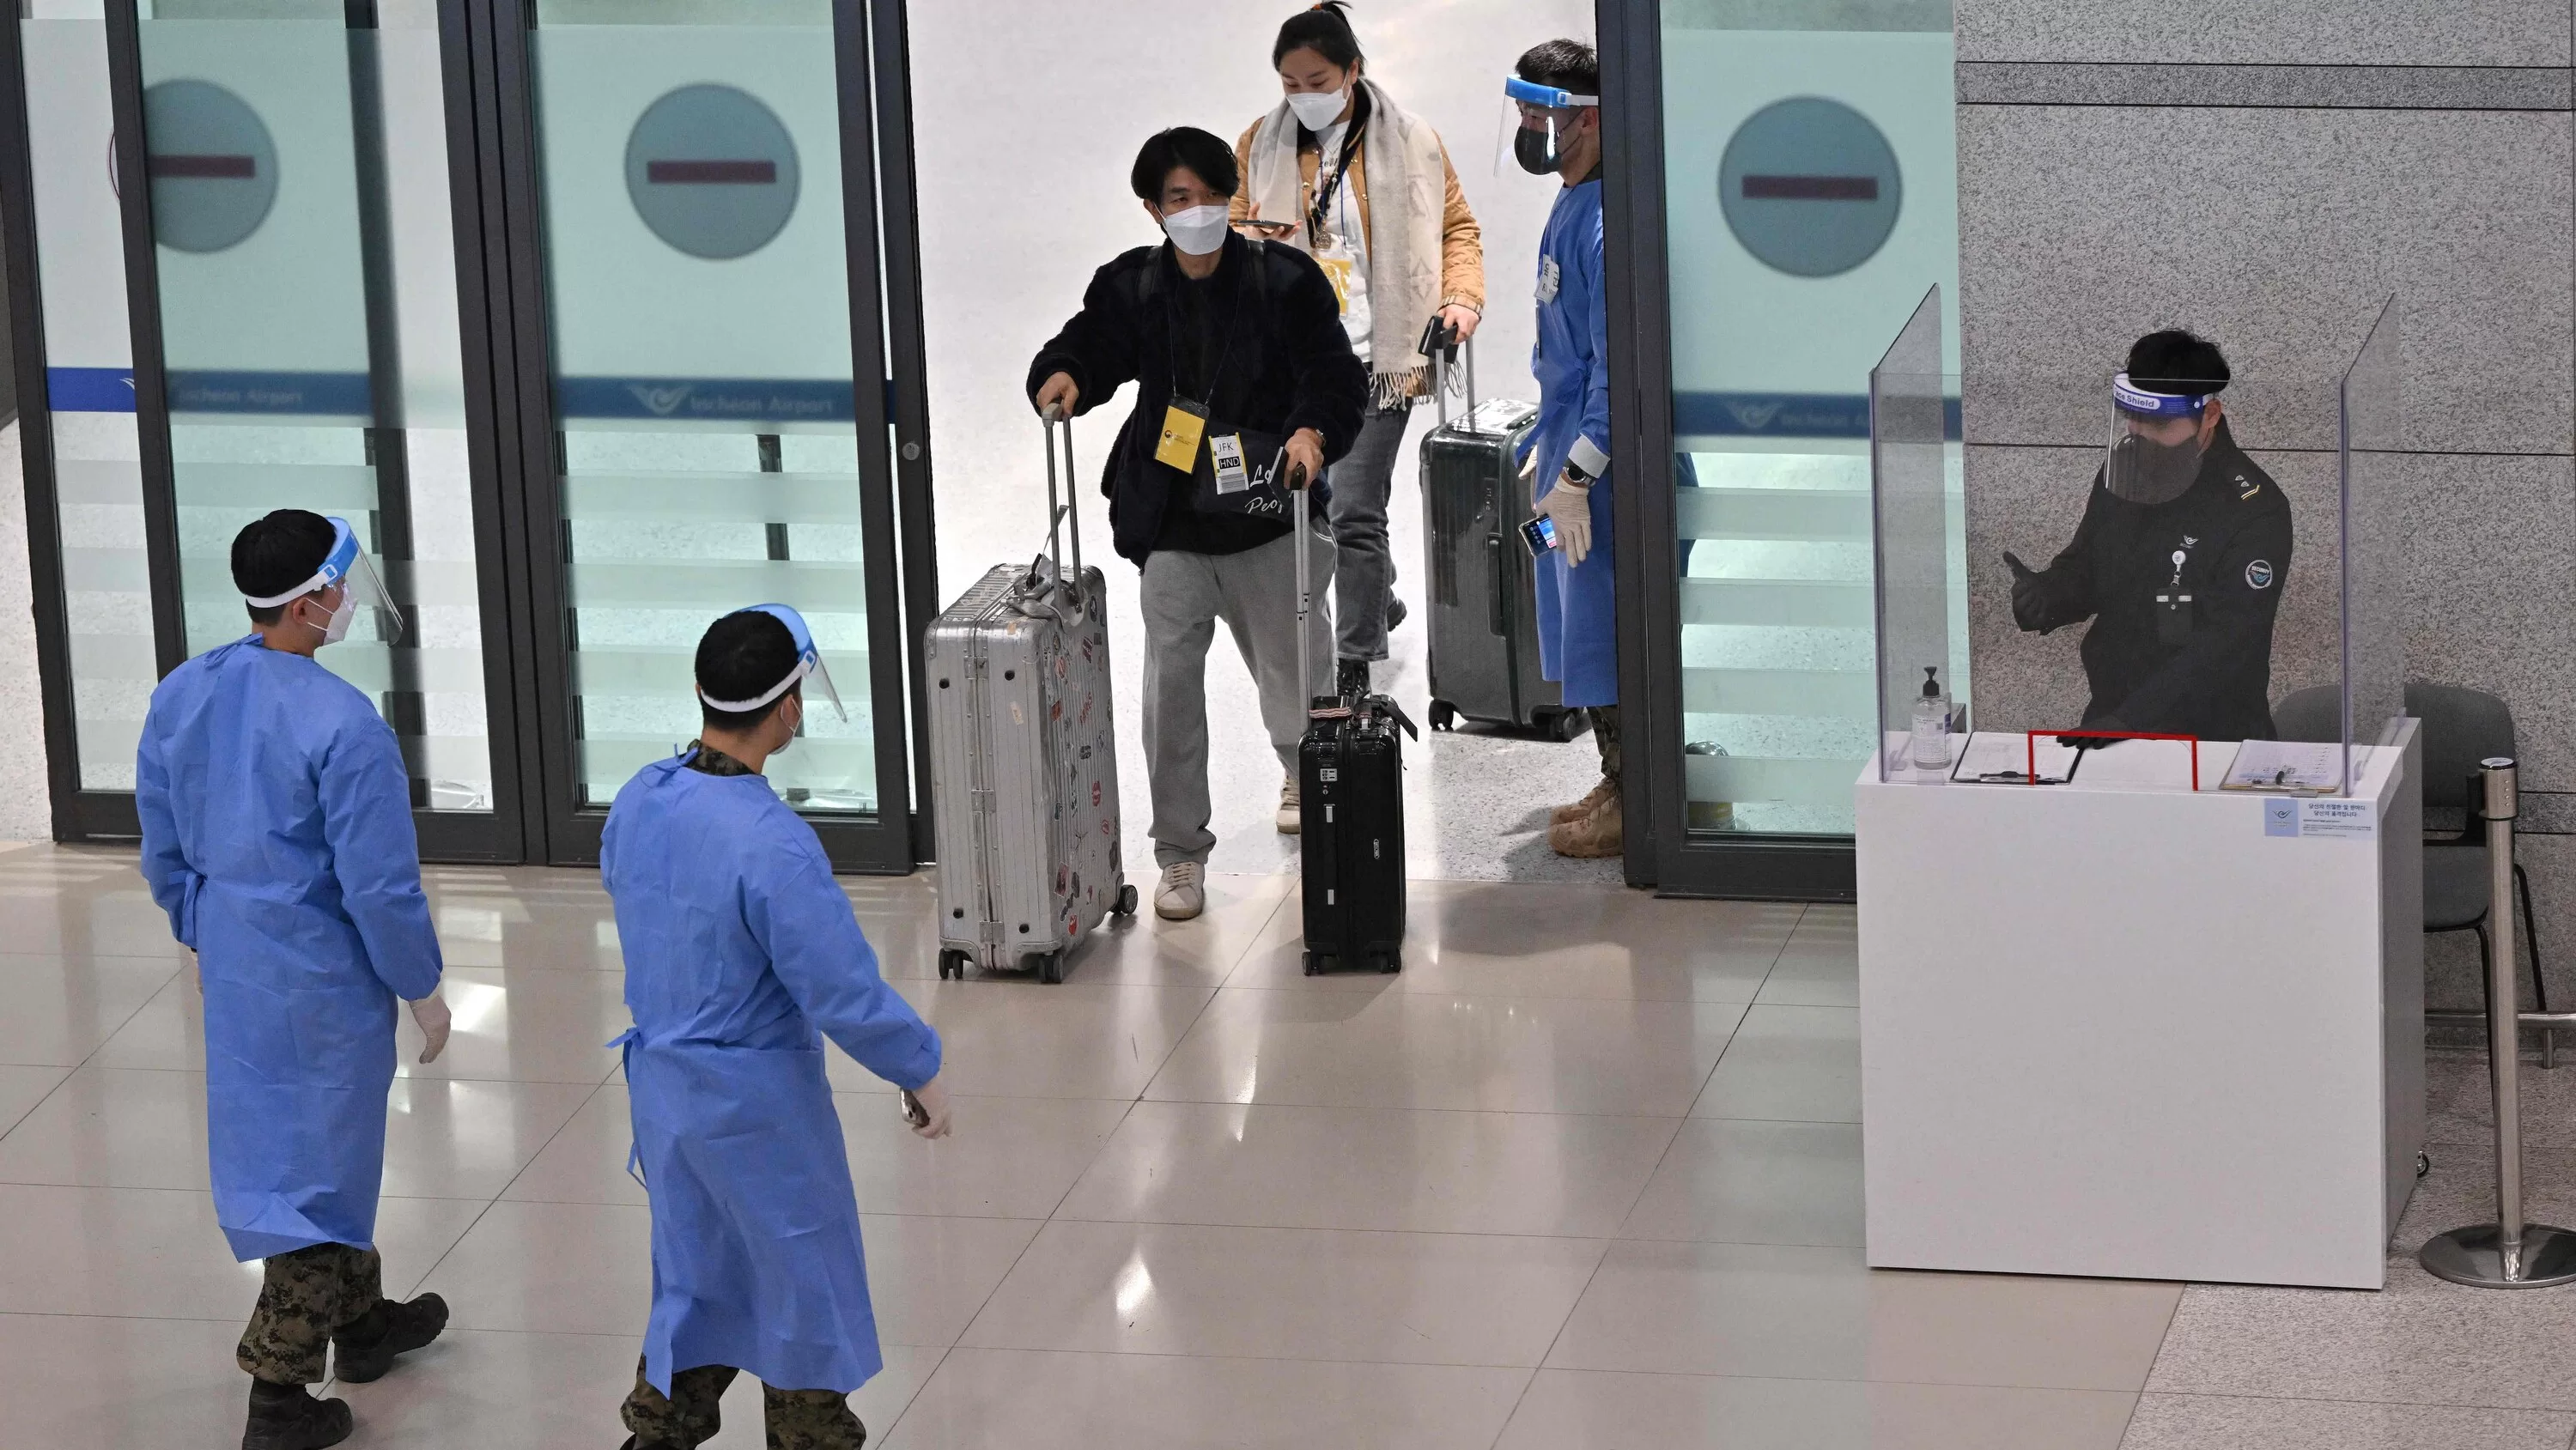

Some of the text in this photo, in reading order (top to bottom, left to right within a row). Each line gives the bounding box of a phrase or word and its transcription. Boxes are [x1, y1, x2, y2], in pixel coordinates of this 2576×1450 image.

[2126, 395, 2155, 408] Shield
[1218, 442, 1234, 453] JFK
[1219, 457, 1240, 469] HND
